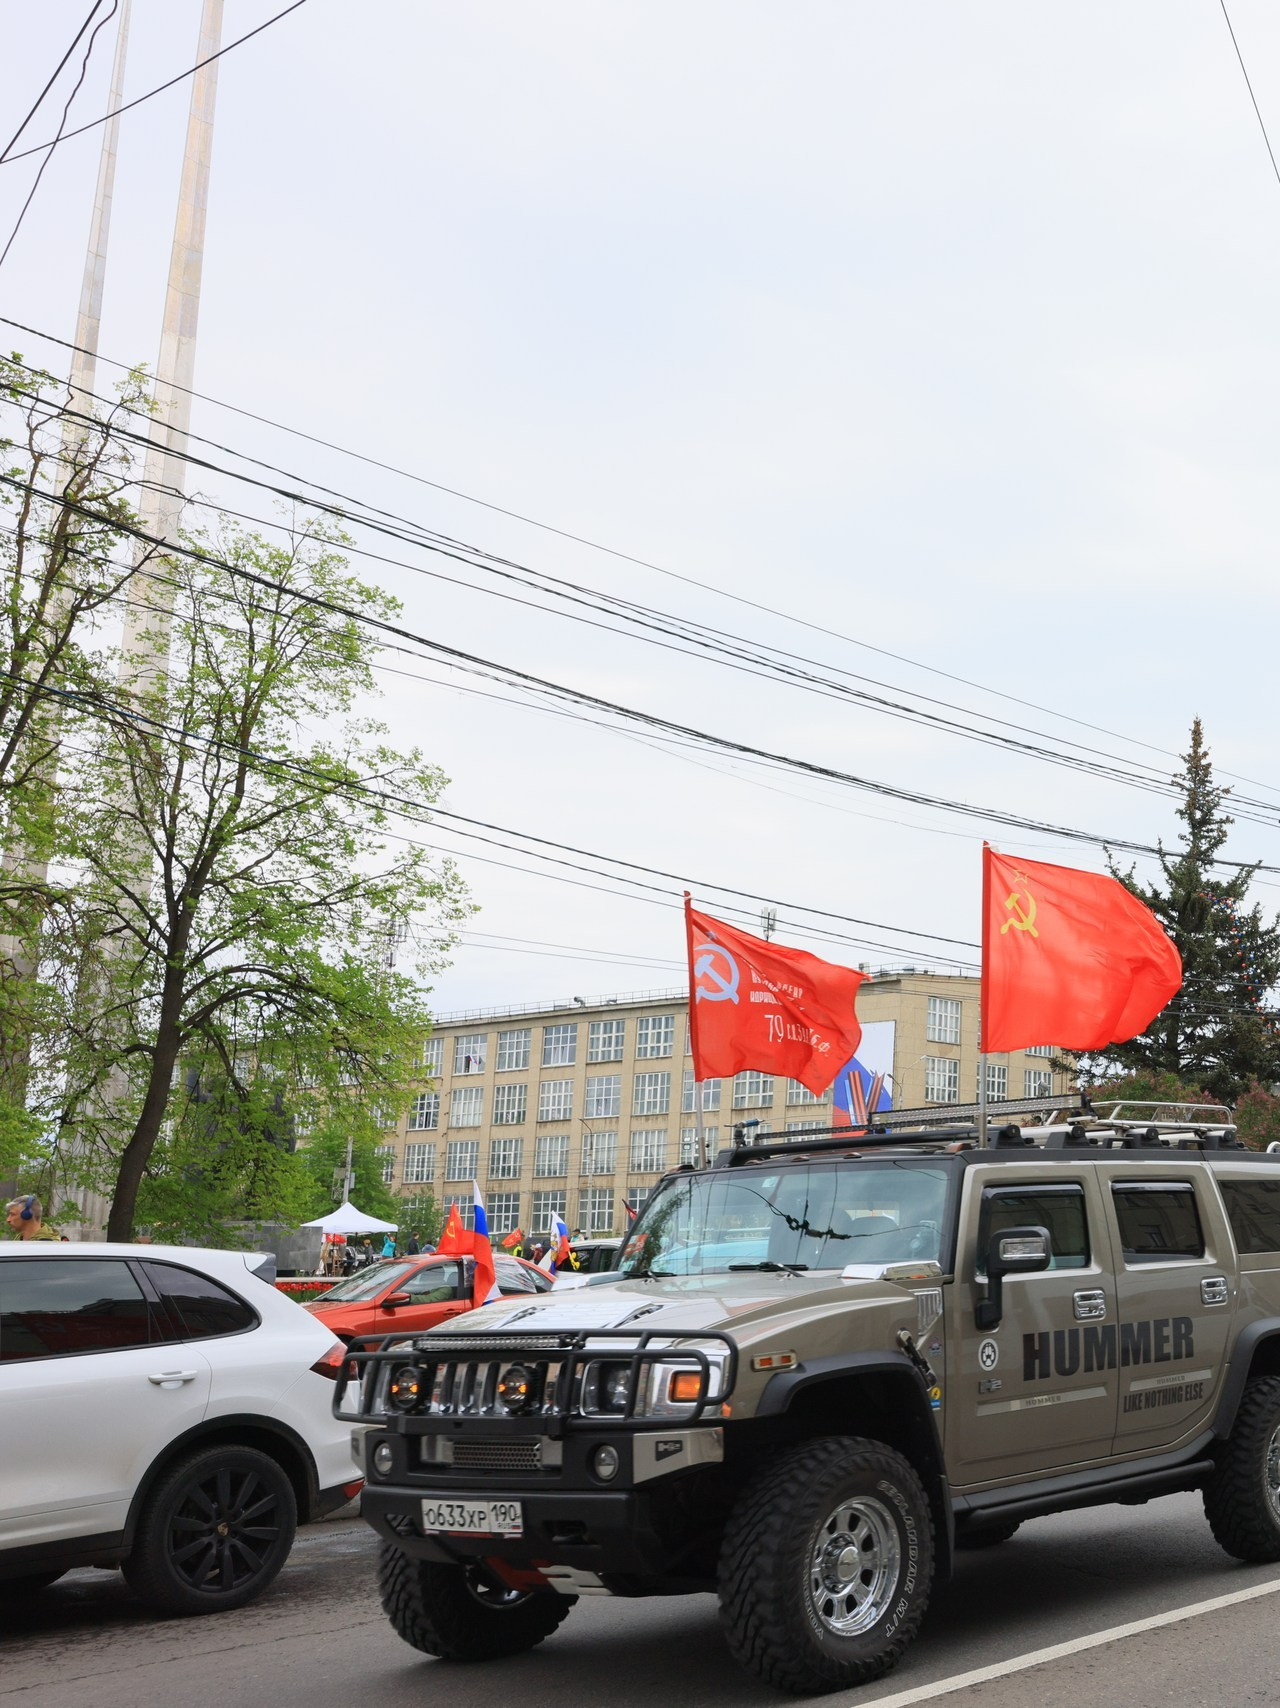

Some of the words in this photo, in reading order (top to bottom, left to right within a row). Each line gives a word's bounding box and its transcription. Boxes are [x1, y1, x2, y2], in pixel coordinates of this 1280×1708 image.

[764, 1014, 785, 1042] 79
[1023, 1317, 1194, 1381] HUMMER
[1123, 1393, 1143, 1413] LIKE
[1144, 1386, 1183, 1409] NOTHING
[1185, 1383, 1203, 1401] ELSE
[426, 1504, 487, 1528] О633ХР
[491, 1504, 516, 1521] 190
[885, 1598, 909, 1637] M/T
